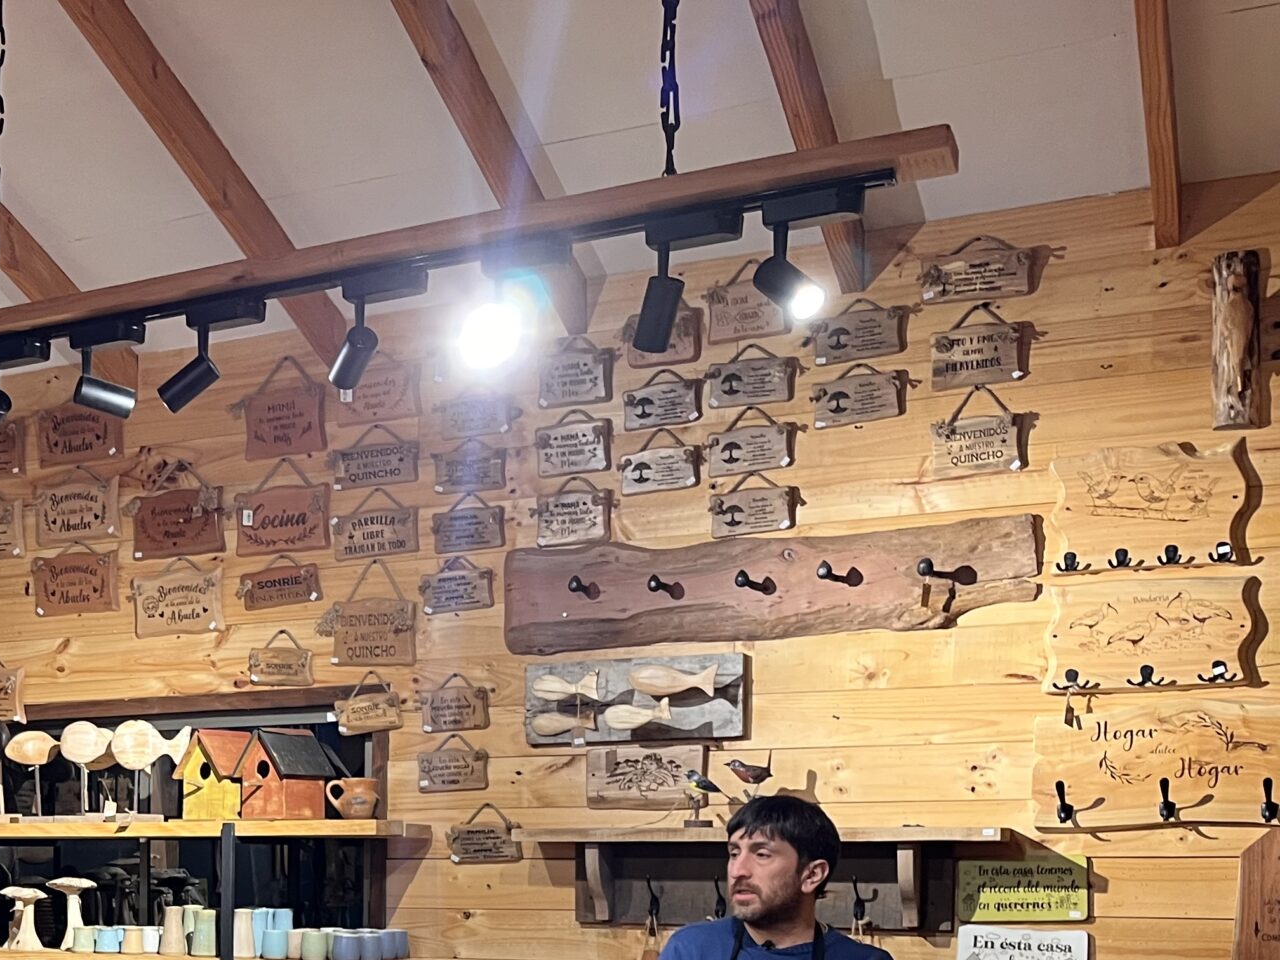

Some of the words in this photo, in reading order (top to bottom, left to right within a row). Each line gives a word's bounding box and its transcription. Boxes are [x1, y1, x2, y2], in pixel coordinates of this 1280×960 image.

[950, 449, 1005, 467] QUINCHO
[348, 467, 402, 483] QUINCHO
[49, 491, 99, 512] Bienvenidos
[59, 516, 93, 533] Abuelos
[251, 503, 310, 532] Cocina
[351, 514, 396, 532] PARRILLA
[362, 528, 386, 541] LIBRE
[376, 540, 388, 552] DE
[388, 538, 407, 551] TODO
[49, 564, 99, 583] Bienvenidos
[58, 588, 91, 605] Abuelos
[166, 608, 201, 626] Abuela
[340, 613, 398, 628] BIENVENIDO
[346, 645, 397, 661] QUINCHO
[1090, 720, 1159, 751] Hogar
[1174, 757, 1245, 789] Hogar
[978, 864, 990, 877] En
[1036, 864, 1074, 877] tenemos
[1023, 879, 1041, 893] del
[1043, 878, 1080, 894] mundo
[978, 901, 990, 911] en
[993, 900, 1053, 913] querernos
[972, 934, 996, 950] En
[999, 937, 1033, 952] ésta
[1036, 941, 1074, 954] casa
